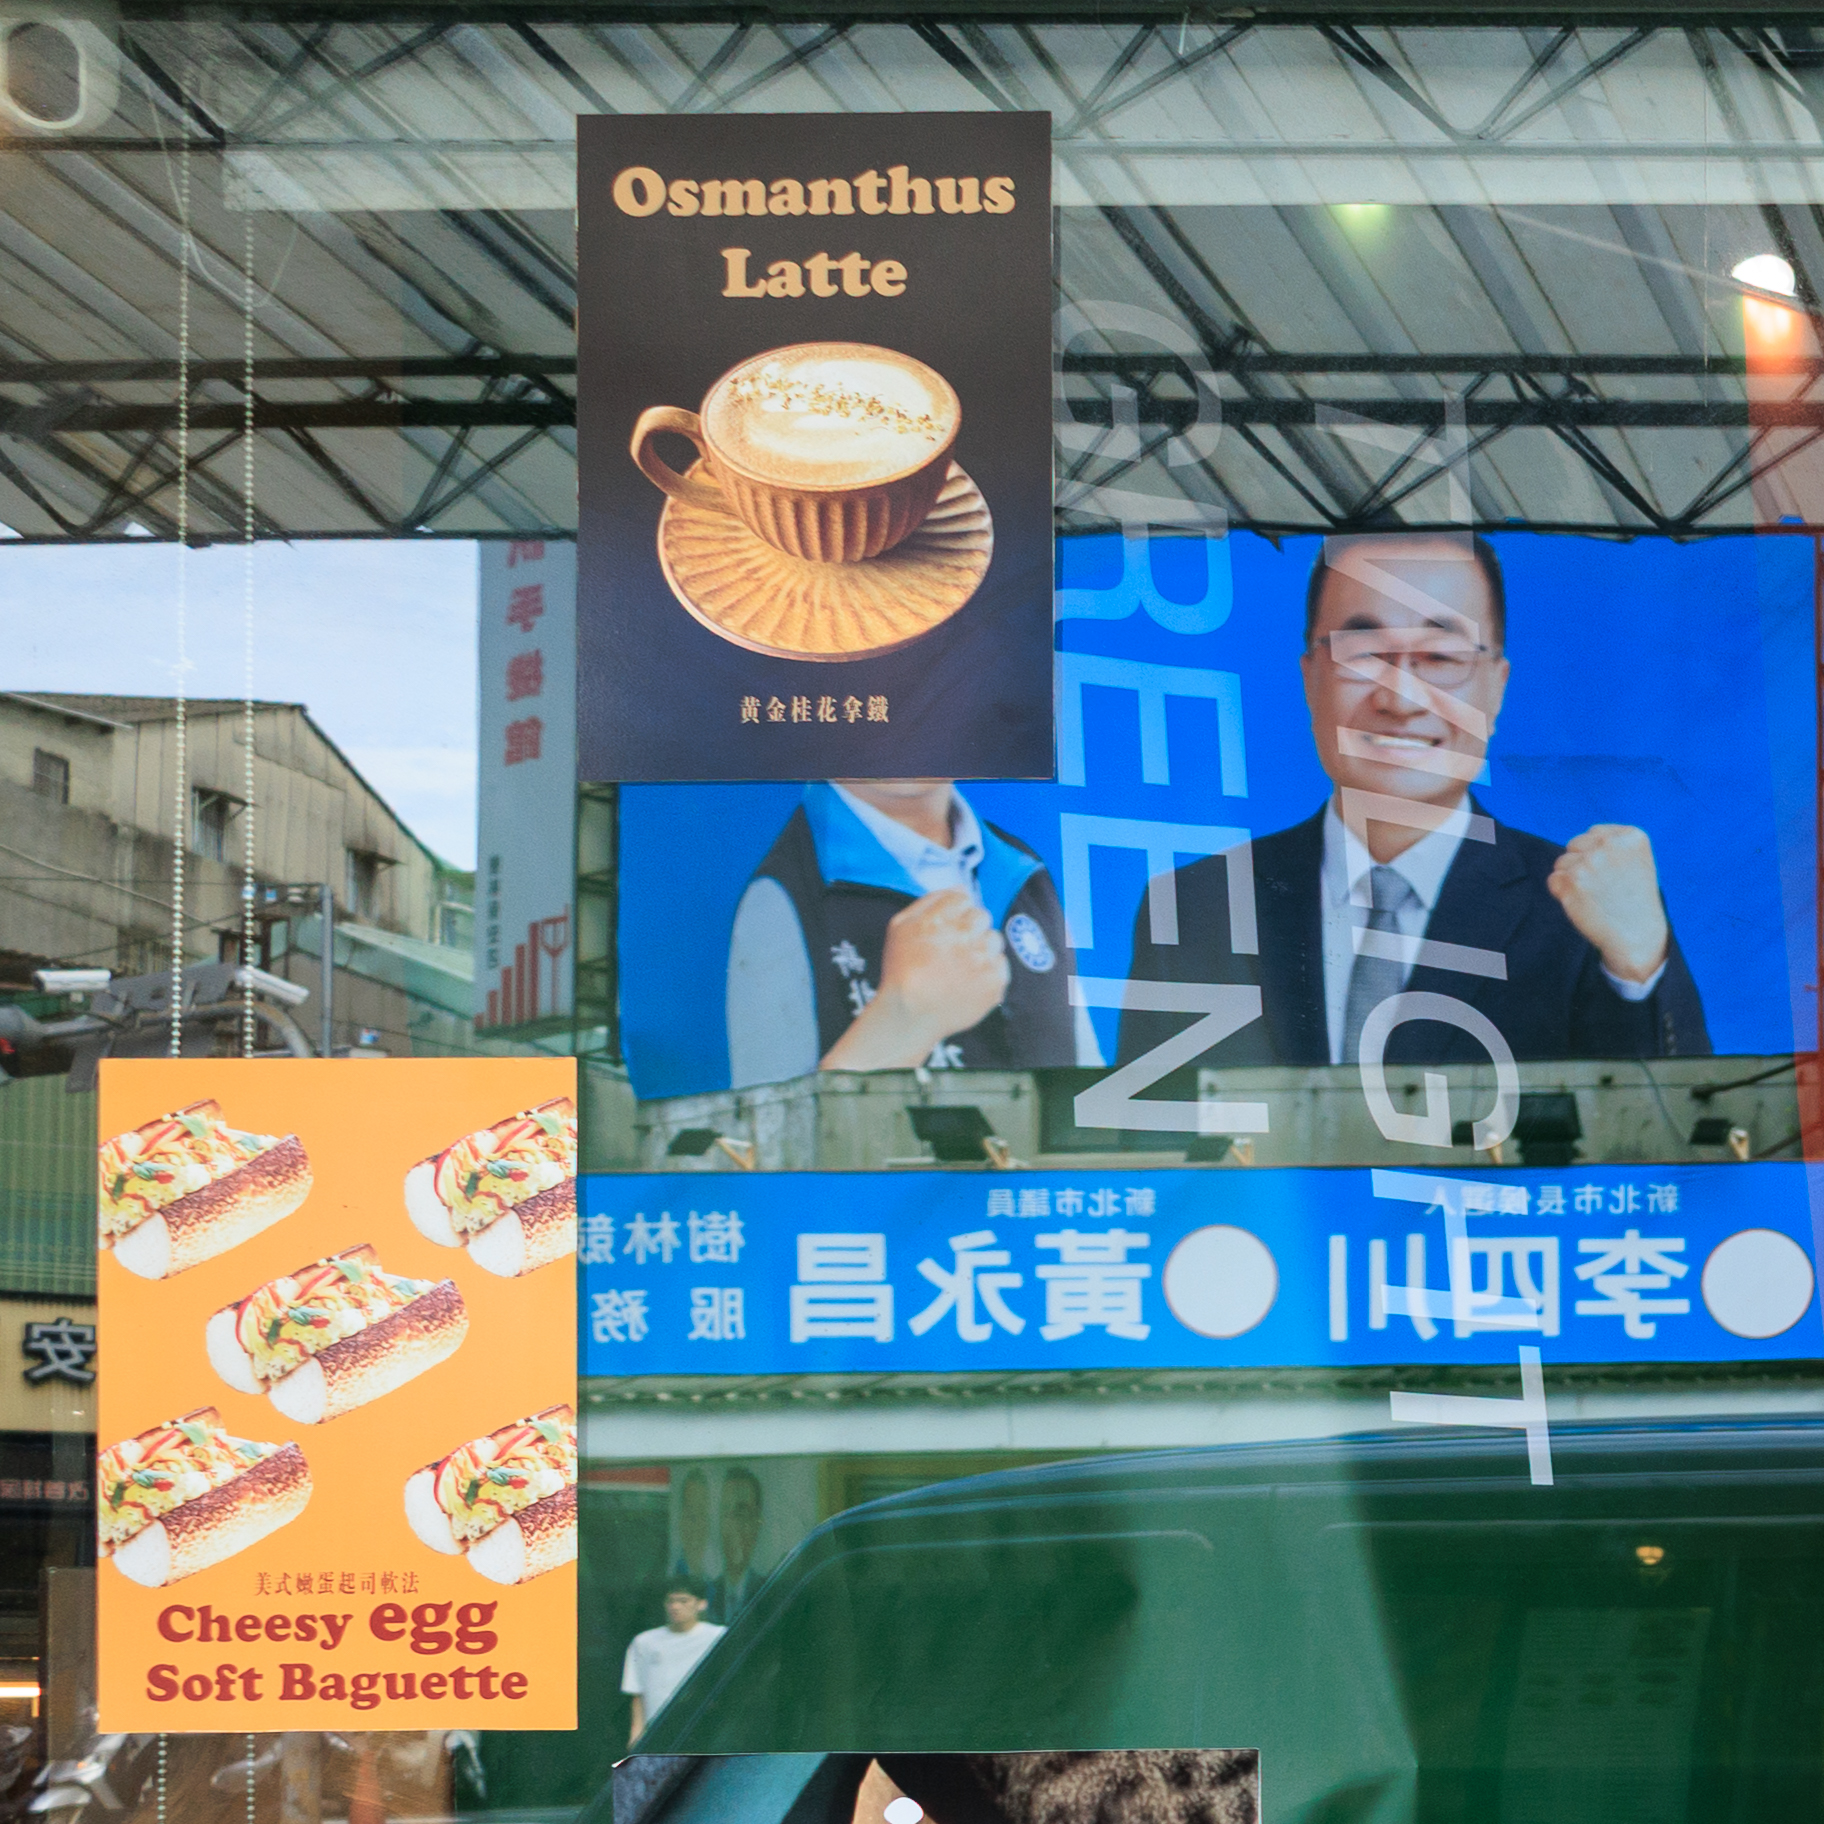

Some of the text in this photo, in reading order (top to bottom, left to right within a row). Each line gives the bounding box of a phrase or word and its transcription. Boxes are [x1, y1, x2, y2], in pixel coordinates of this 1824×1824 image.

[613, 166, 1017, 217] Osmanthus
[721, 248, 908, 298] Latte
[740, 695, 890, 724] 黃金桂花拿鐵
[254, 1571, 420, 1596] 美式嫩蛋起司軟法
[157, 1600, 498, 1655] Cheesy egg
[146, 1663, 528, 1710] Soft Baguette
